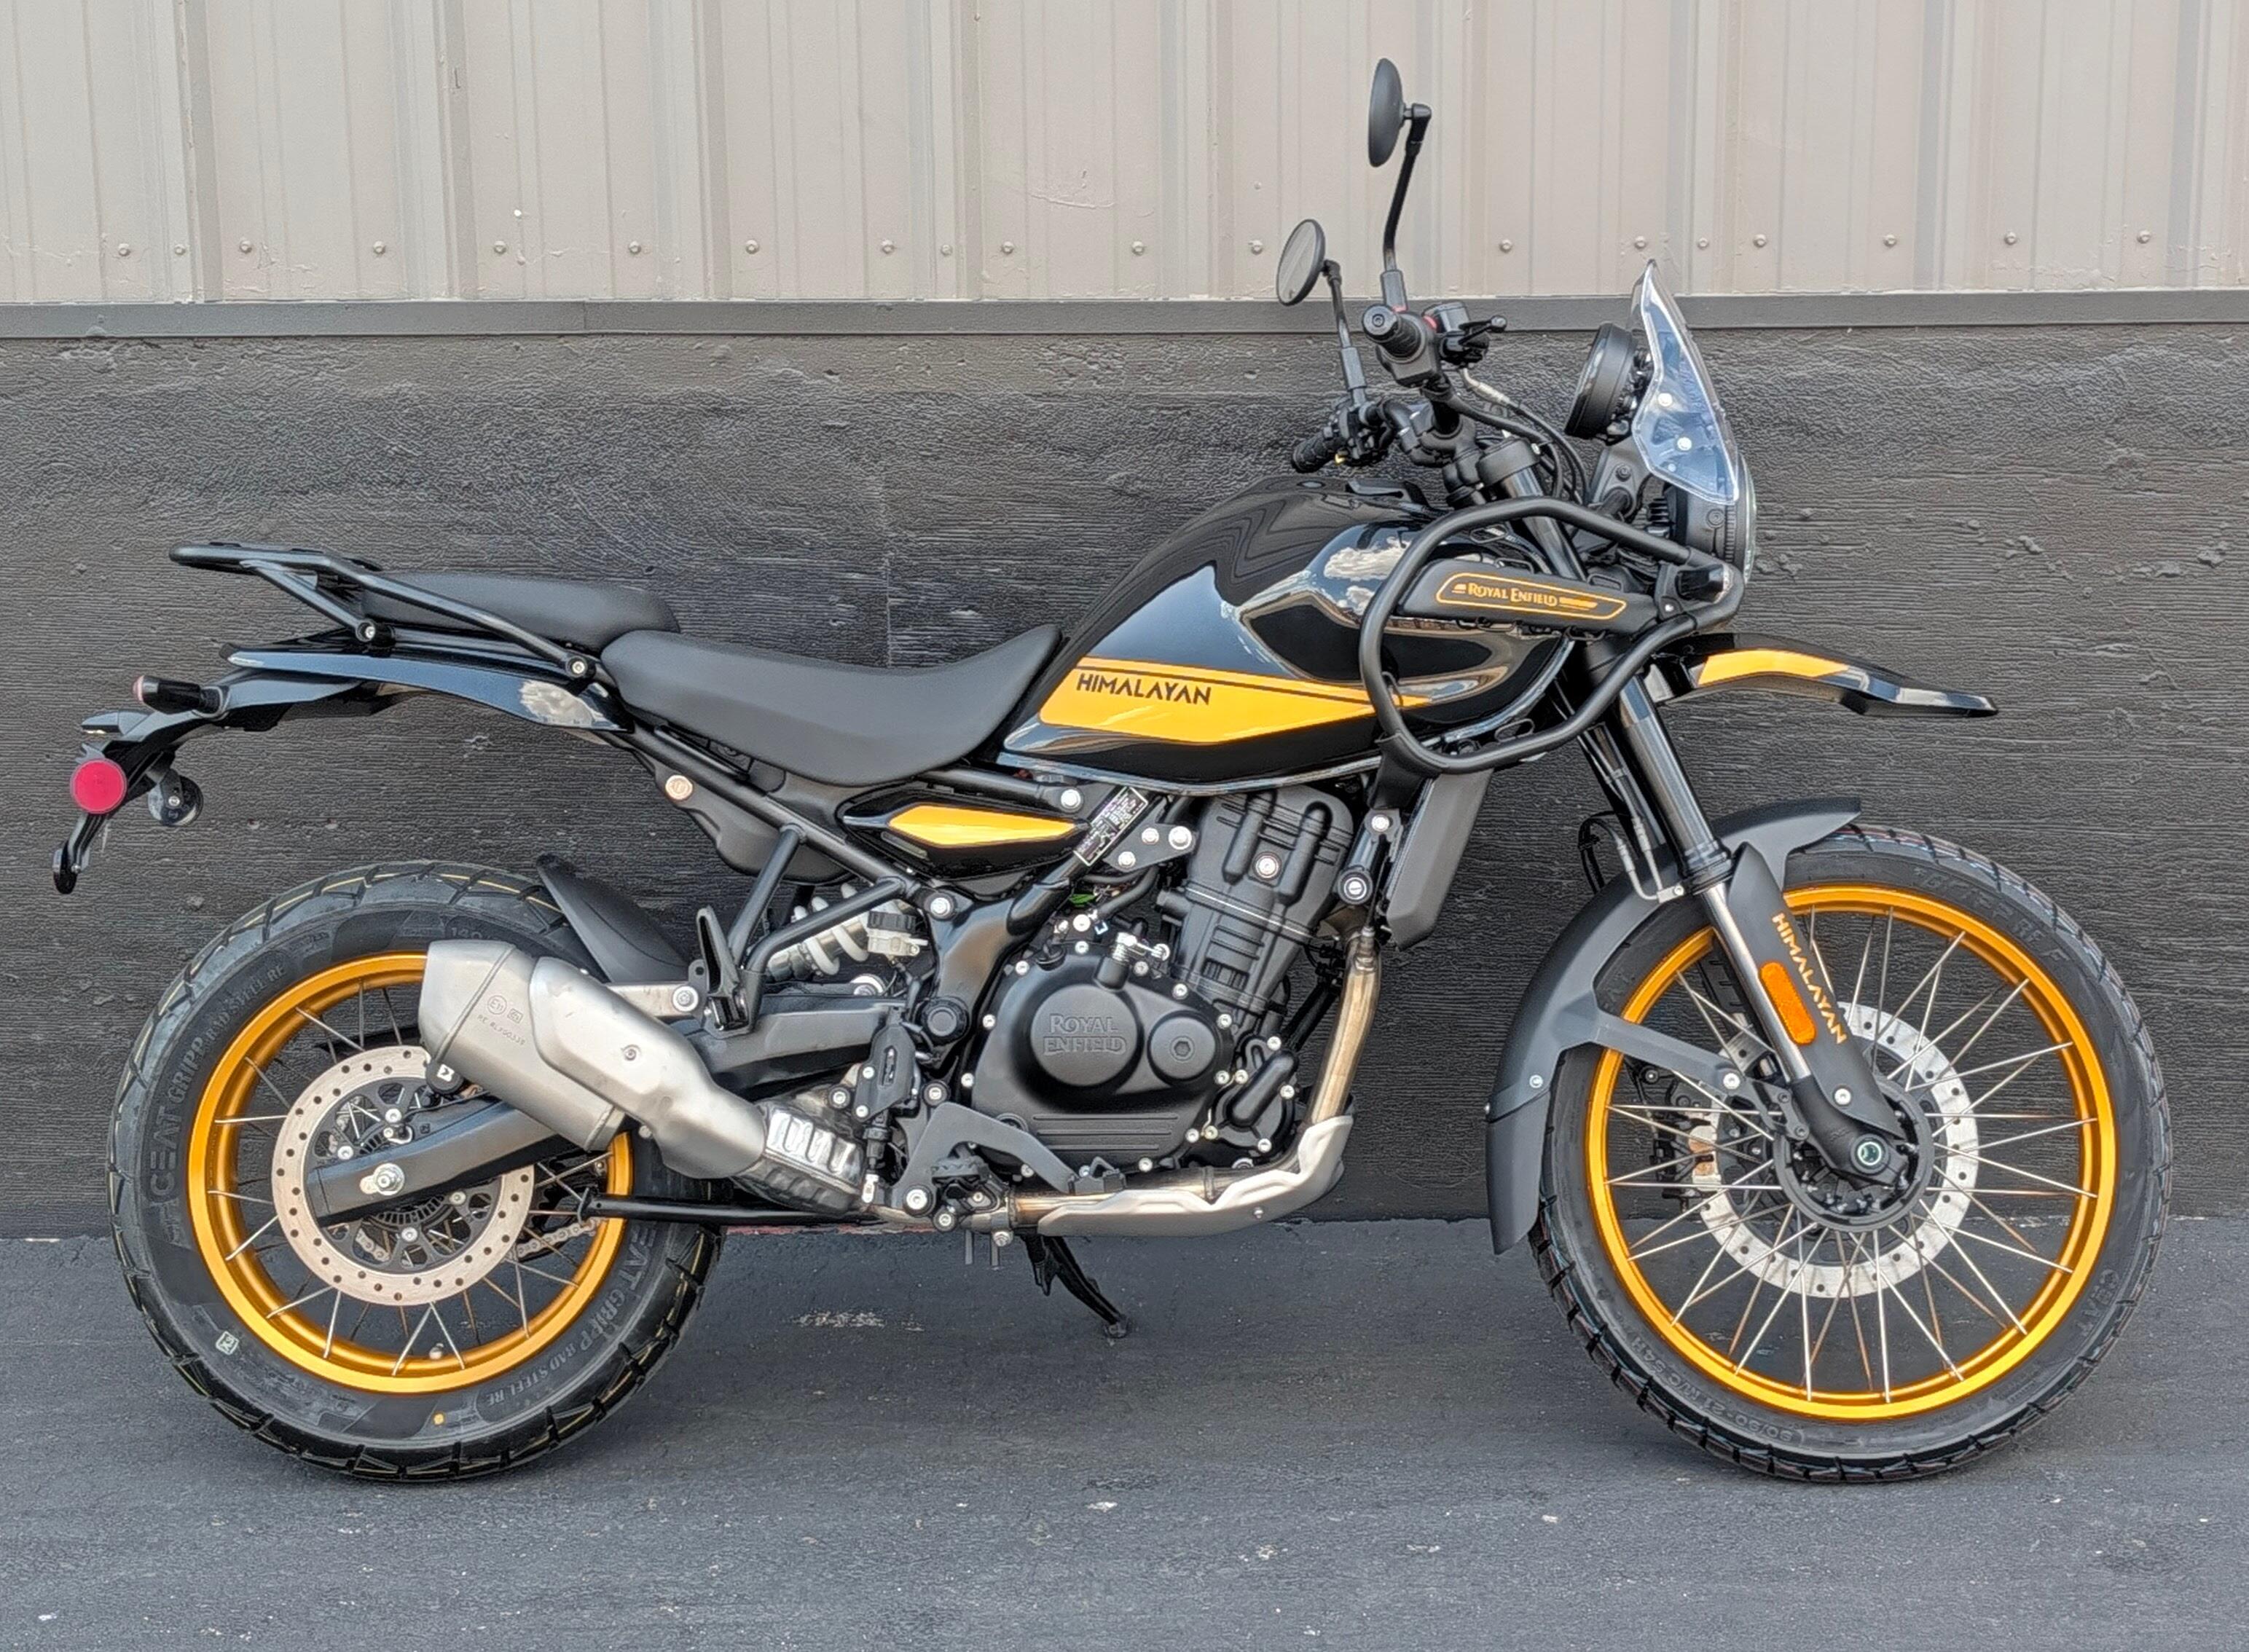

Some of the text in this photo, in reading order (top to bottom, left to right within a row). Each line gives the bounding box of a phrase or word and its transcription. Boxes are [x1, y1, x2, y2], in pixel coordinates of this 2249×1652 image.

[1468, 583, 1558, 607] ROYAL ENFIELD
[1077, 673, 1212, 705] HIMALAYAN
[1772, 913, 1847, 1044] HIMALAYAN
[1049, 1013, 1118, 1034] ROYAL
[1043, 1036, 1127, 1055] ENFIELD
[149, 1106, 181, 1196] CEAT
[168, 1037, 204, 1103] GRIPP
[267, 964, 286, 983] RE
[620, 1225, 656, 1290] EAT
[581, 1289, 626, 1350] GRIPP
[511, 1367, 548, 1392] STEEL
[486, 1390, 505, 1406] RE
